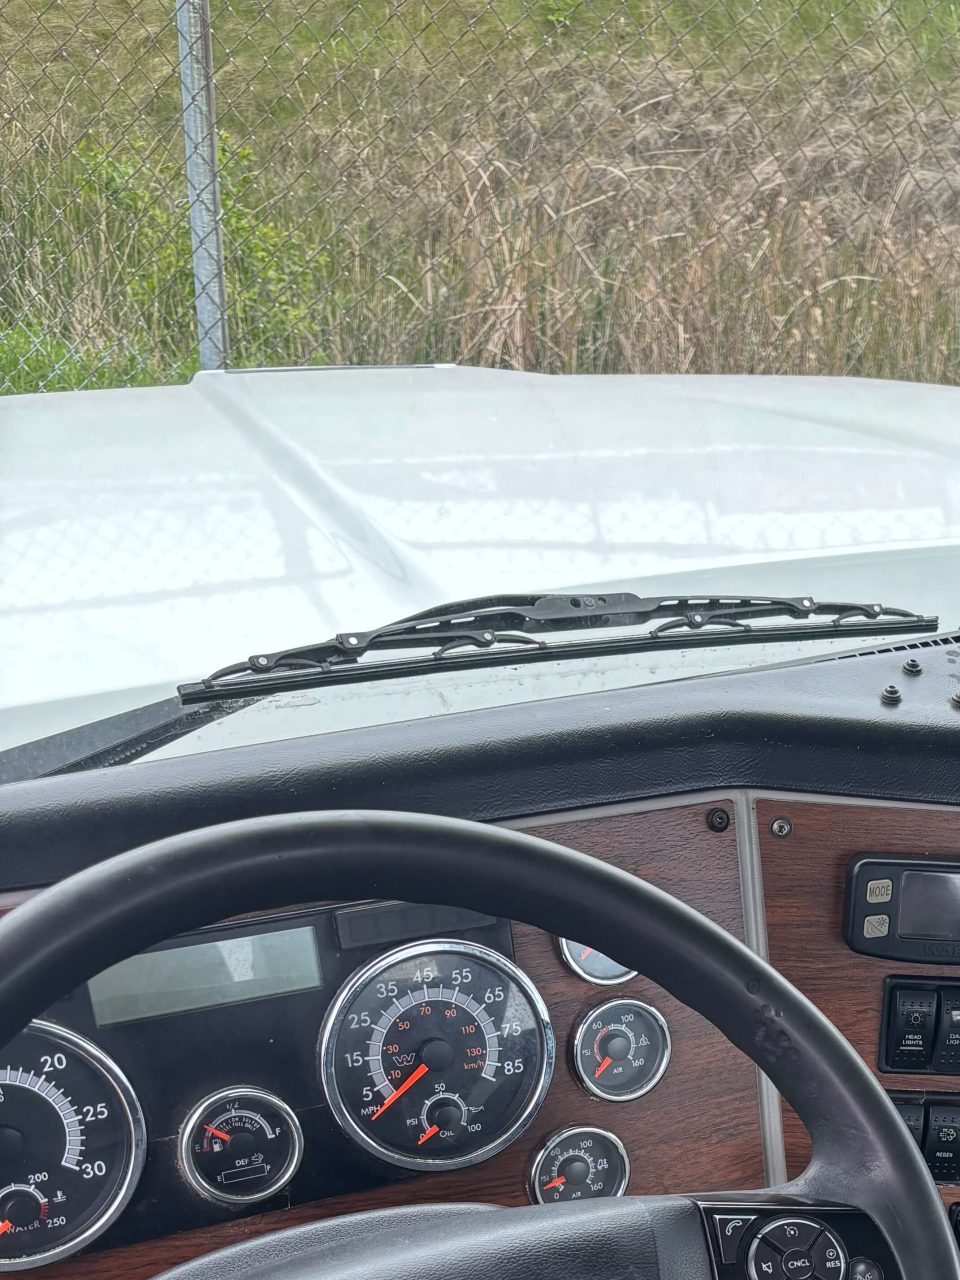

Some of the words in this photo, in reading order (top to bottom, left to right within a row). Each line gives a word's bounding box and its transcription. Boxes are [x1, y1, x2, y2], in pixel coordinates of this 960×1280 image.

[868, 884, 890, 898] MODE
[413, 968, 433, 983] 45
[452, 968, 472, 985] 55
[376, 981, 398, 998] 35
[484, 987, 504, 1003] 65
[419, 1007, 432, 1016] 70
[444, 1008, 457, 1018] 90
[349, 1012, 371, 1029] 25
[621, 1014, 634, 1023] 100
[398, 1021, 411, 1030] 50
[461, 1025, 476, 1035] 110
[502, 1021, 521, 1038] 75
[592, 1021, 603, 1030] 60
[387, 1045, 399, 1053] 30
[466, 1048, 482, 1056] 130
[40, 1053, 67, 1072] 20
[344, 1051, 363, 1068] 15
[631, 1058, 645, 1067] 160
[463, 1060, 484, 1070] km/h
[504, 1059, 524, 1075] 85
[390, 1070, 401, 1079] 10
[434, 1083, 446, 1092] 50
[362, 1086, 373, 1101] 5
[83, 1103, 109, 1122] 25
[361, 1105, 381, 1116] MPH
[406, 1118, 418, 1126] PSI
[275, 1128, 281, 1136] F
[467, 1124, 482, 1133] 100
[439, 1130, 454, 1138] OIL
[580, 1139, 593, 1149] 100
[550, 1148, 561, 1157] 60
[235, 1159, 249, 1167] DEF
[81, 1160, 106, 1179] 30
[28, 1171, 49, 1184] 200
[590, 1182, 603, 1191] 160
[571, 1191, 582, 1199] AIR
[46, 1216, 67, 1228] 250
[788, 1258, 810, 1269] CNCL
[826, 1260, 841, 1268] RES
